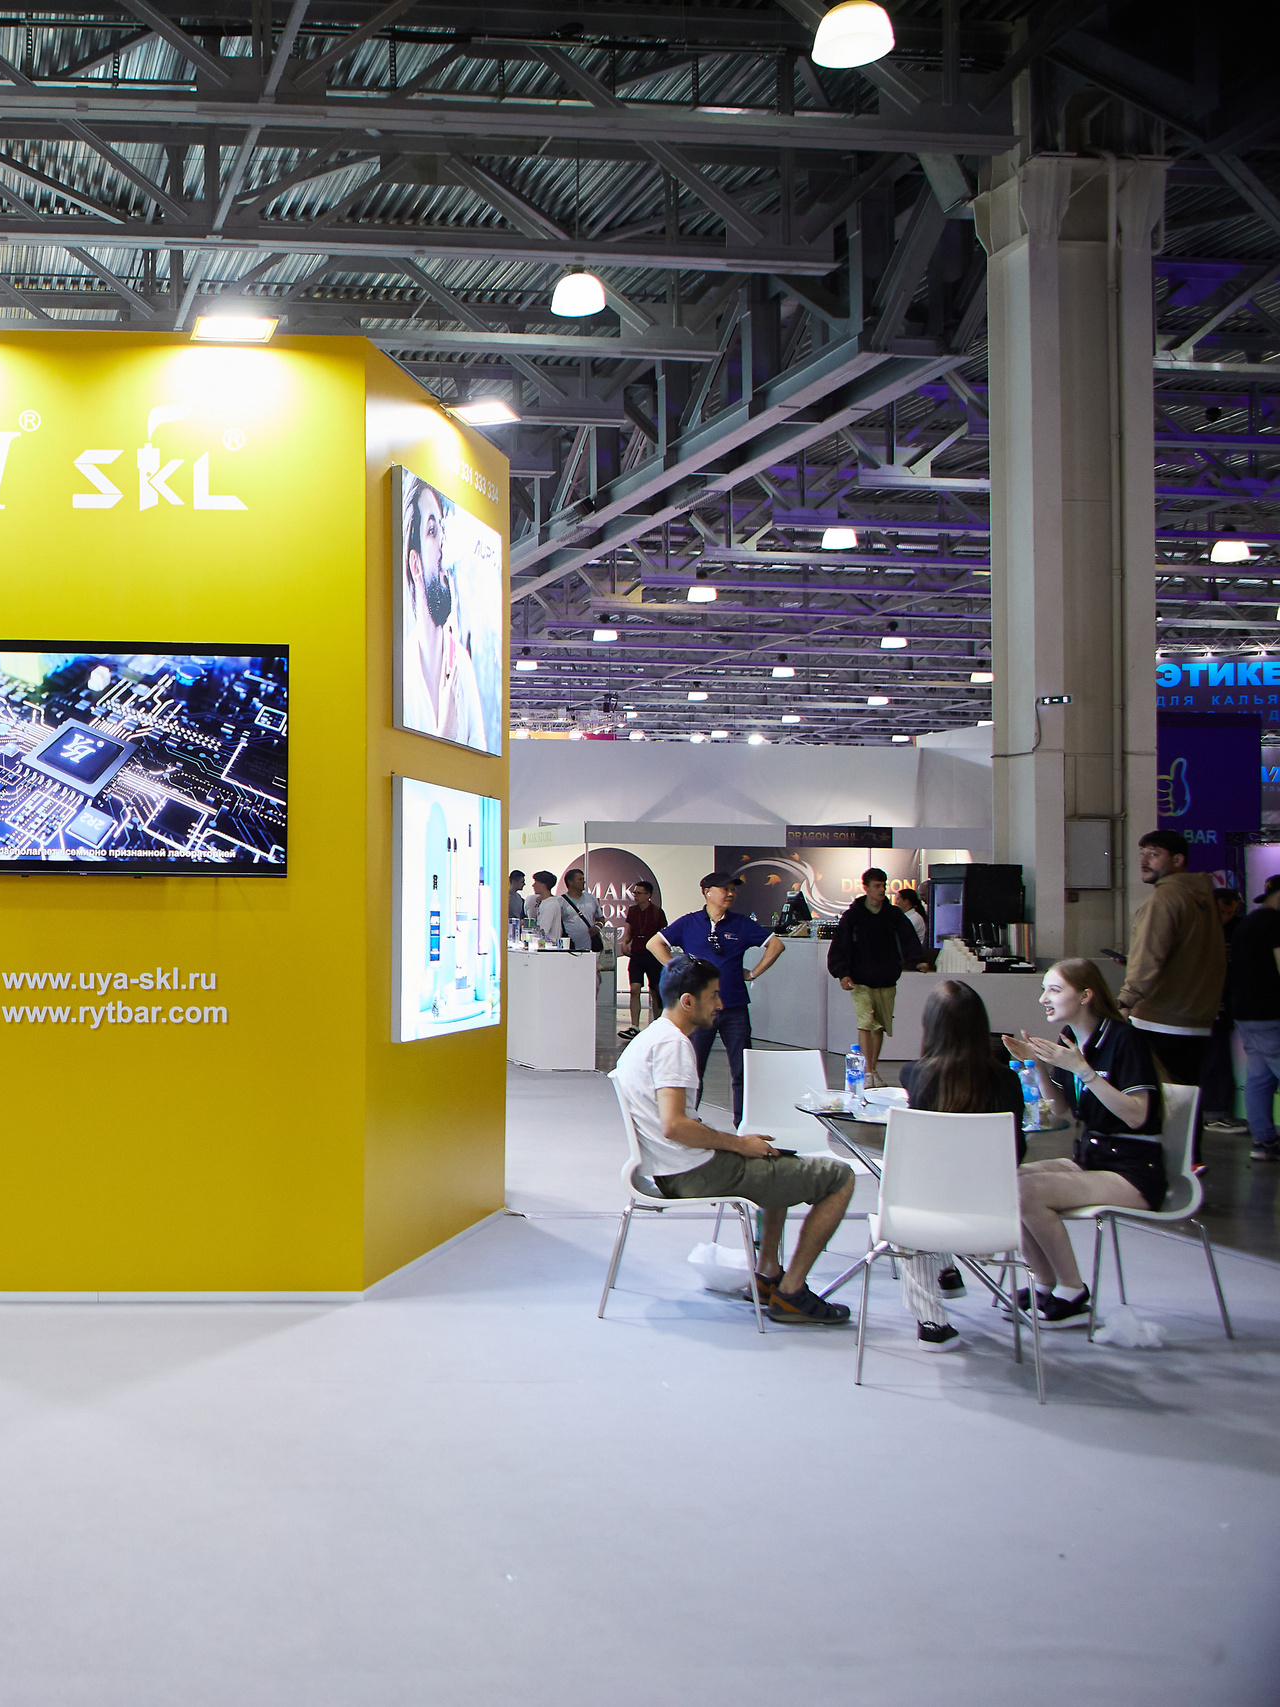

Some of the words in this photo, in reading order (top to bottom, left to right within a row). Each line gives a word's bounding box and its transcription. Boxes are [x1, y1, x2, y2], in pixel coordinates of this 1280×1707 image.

[787, 831, 830, 841] DRAGON
[109, 848, 166, 858] признанной
[2, 967, 217, 995] www.uya-skl.ru
[2, 1001, 229, 1029] www.rytbar.com
